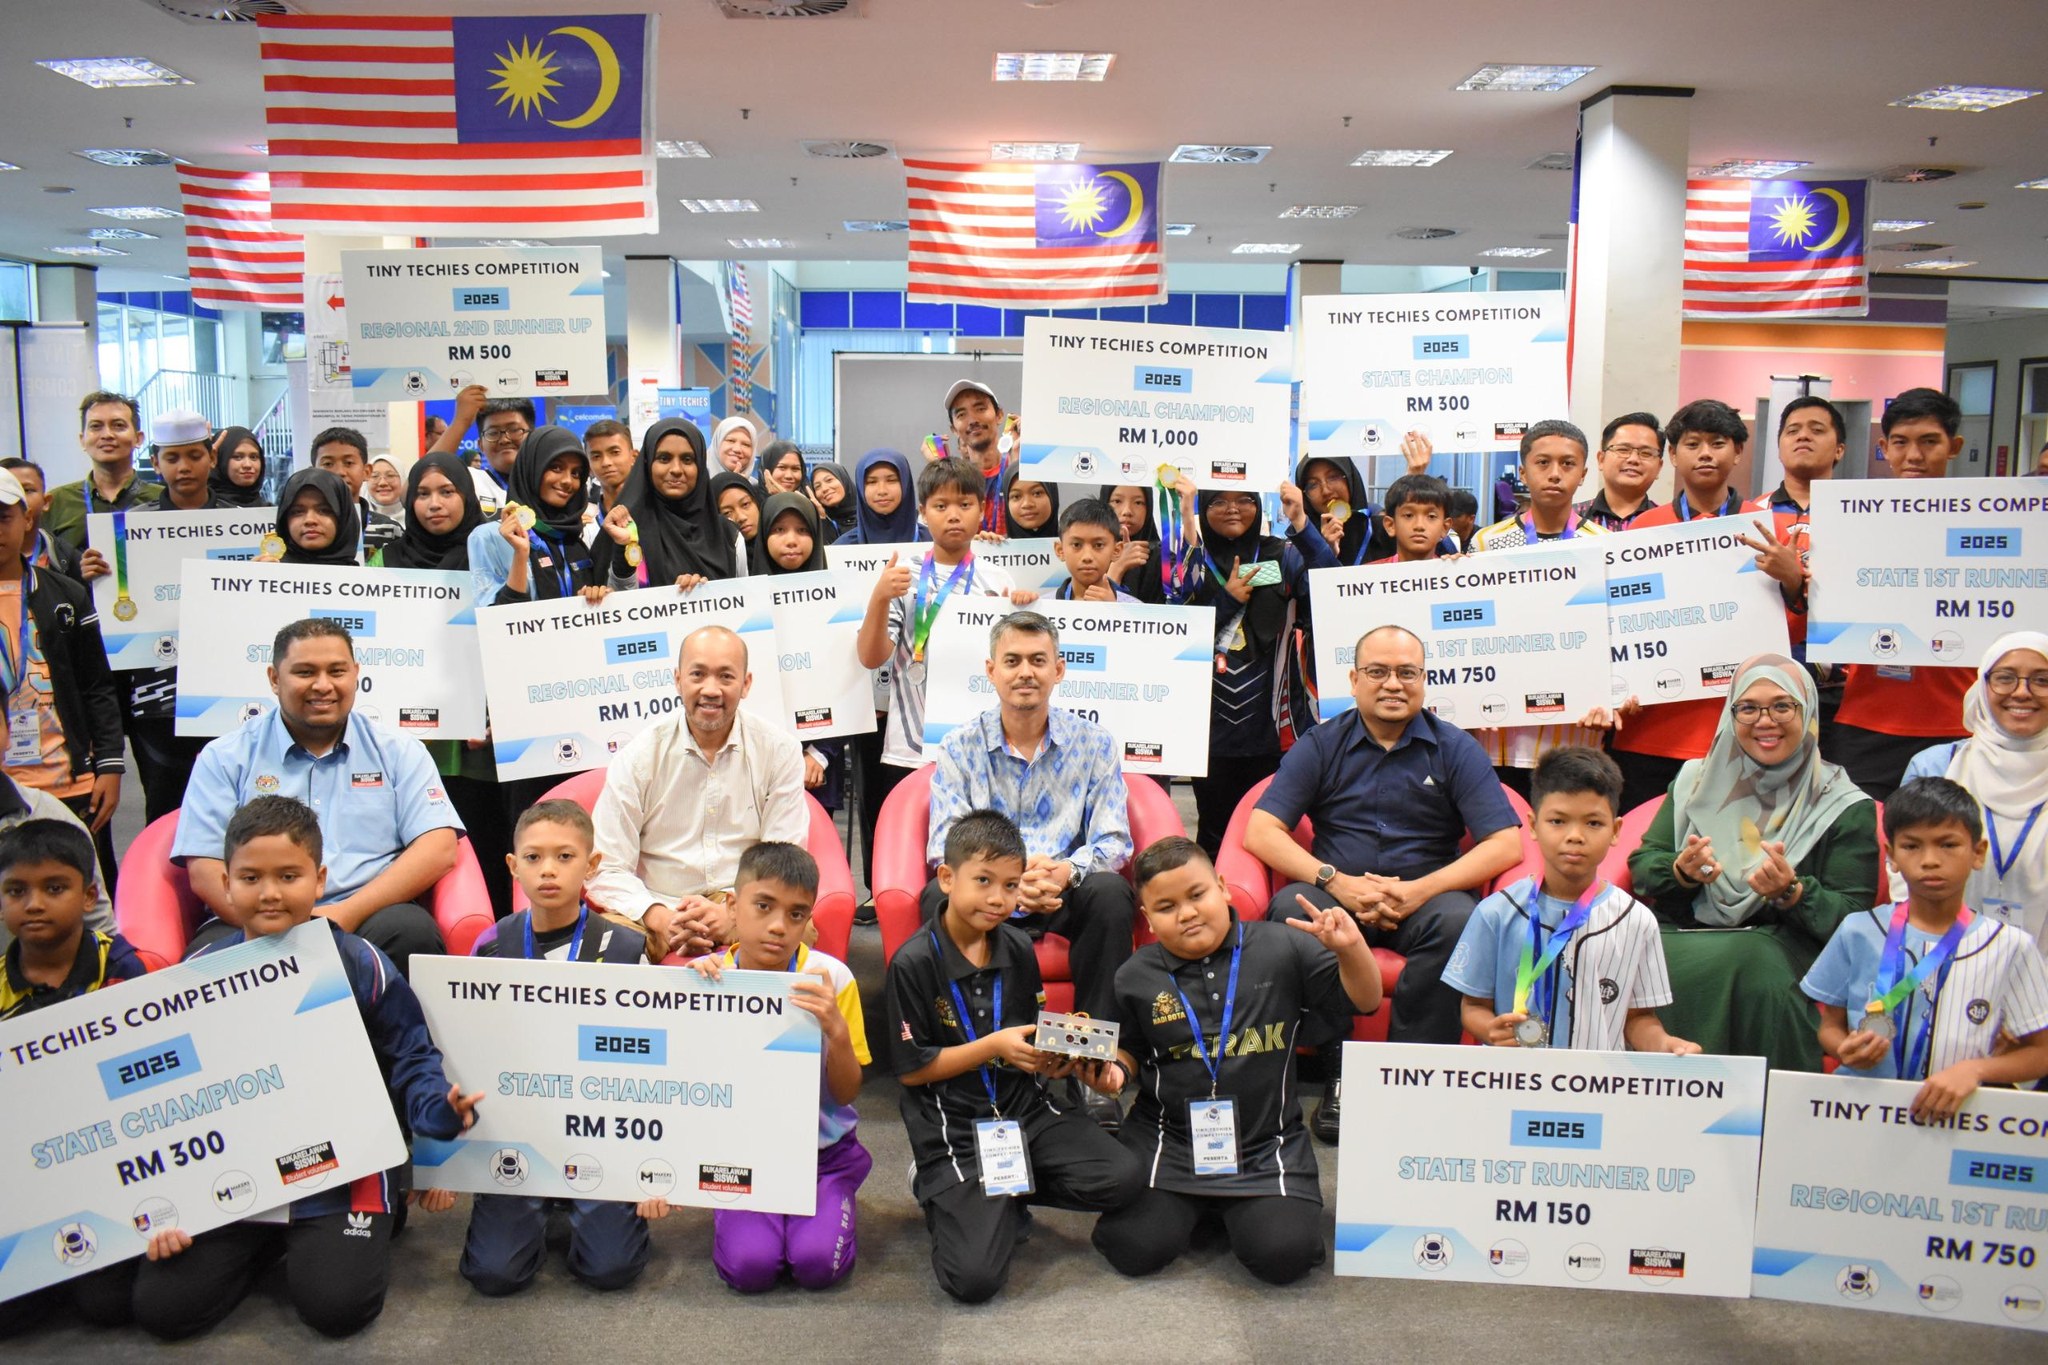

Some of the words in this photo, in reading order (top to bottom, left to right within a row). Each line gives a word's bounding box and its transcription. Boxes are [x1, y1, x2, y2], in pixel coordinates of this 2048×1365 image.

[367, 263, 402, 277] TINY
[407, 263, 470, 276] TECHIES
[475, 262, 580, 275] COMPETITION
[464, 294, 499, 305] 2025
[1328, 311, 1362, 325] TINY
[1367, 310, 1430, 323] TECHIES
[1435, 307, 1541, 322] COMPETITION
[360, 321, 451, 339] REGIONAL
[454, 320, 489, 336] 2ND
[493, 318, 565, 335] RUNNER
[569, 318, 592, 333] UP
[448, 346, 474, 360] RM
[480, 345, 511, 359] 500
[1049, 335, 1085, 349] TINY
[1091, 337, 1155, 353] TECHIES
[1160, 341, 1268, 359] COMPETITION
[1423, 341, 1459, 353] 2025
[1145, 373, 1181, 386] 2025
[1362, 370, 1411, 387] STATE
[1415, 368, 1513, 387] CHAMPION
[660, 397, 676, 407] TINY
[679, 397, 708, 407] TECHIES
[1058, 396, 1150, 418] REGIONAL
[1154, 401, 1254, 423] CHAMPION
[1407, 396, 1433, 412] RM
[1438, 395, 1470, 411] 300
[1119, 427, 1146, 444] RM
[1151, 429, 1198, 448] 1,000
[1840, 499, 1884, 513] TINY
[1891, 498, 1971, 512] TECHIES
[125, 528, 151, 541] INY
[158, 524, 224, 539] TECHIES
[1961, 536, 2008, 549] 2025
[1621, 533, 1746, 563] COMPETITION
[983, 554, 1050, 566] PETITION
[1336, 582, 1375, 597] TINY
[1380, 576, 1450, 594] TECHIES
[1455, 566, 1577, 588] COMPETITION
[1856, 567, 1919, 588] STATE
[1924, 568, 1960, 588] 1ST
[211, 577, 253, 592] TINY
[259, 580, 333, 595] TECHIES
[338, 583, 461, 599] COMPETITION
[773, 587, 836, 605] ETITION
[1610, 582, 1652, 599] 2025
[506, 618, 545, 636] TINY
[551, 610, 622, 630] TECHIES
[628, 595, 745, 621] COMPETITION
[1443, 608, 1483, 622] 2025
[1619, 606, 1706, 634] RUNNER
[1710, 602, 1739, 621] UP
[1936, 600, 1970, 618] RM
[1978, 600, 2015, 618] 150
[323, 617, 364, 630] 025
[957, 612, 994, 625] TINY
[1072, 618, 1188, 636] COMPETITION
[617, 640, 657, 656] 2025
[1437, 639, 1467, 657] 1ST
[1471, 633, 1556, 655] RUNNER
[1560, 630, 1587, 650] UP
[1611, 646, 1629, 663] M
[1634, 640, 1668, 660] 150
[355, 648, 424, 667] MPION
[1059, 651, 1095, 663] 2025
[1427, 668, 1456, 685] RM
[1462, 665, 1496, 684] 750
[527, 677, 629, 703] REGIONAL
[1059, 679, 1138, 701] RUNNER
[1143, 684, 1169, 702] UP
[599, 703, 629, 722] RM
[448, 981, 503, 1001] TINY
[509, 984, 607, 1006] TECHIES
[616, 989, 783, 1015] COMPETITION
[10, 1016, 118, 1066] TECHIES
[124, 955, 301, 1028] COMPETITION
[595, 1035, 650, 1055] 2025
[118, 1050, 182, 1085] 2025
[498, 1071, 573, 1099] STATE
[580, 1075, 733, 1108] CHAMPION
[1380, 1068, 1434, 1088] TINY
[1443, 1070, 1542, 1091] TECHIES
[1551, 1074, 1724, 1099] COMPETITION
[31, 1120, 118, 1170] STATE
[120, 1064, 285, 1139] CHAMPION
[1810, 1099, 1870, 1121] TINY
[565, 1114, 606, 1139] RM
[615, 1117, 664, 1142] 300
[1527, 1121, 1585, 1139] 2025
[116, 1150, 166, 1186] RM
[170, 1130, 226, 1167] 300
[293, 1153, 323, 1170] SISWA
[702, 1165, 749, 1177] SUKARELAWAN
[713, 1173, 739, 1184] SISWA
[1398, 1156, 1476, 1183] STATE
[1482, 1160, 1526, 1185] 1ST
[1531, 1162, 1649, 1192] RUNNER
[1656, 1167, 1695, 1193] UP
[1969, 1161, 2034, 1183] 2025
[1496, 1200, 1537, 1223] RM
[1546, 1202, 1591, 1226] 150
[1790, 1184, 1944, 1222] REGIONAL
[1952, 1199, 2000, 1227] 1ST
[343, 1228, 371, 1238] adidas
[1633, 1250, 1682, 1260] SUKARELAWAN
[1926, 1235, 1973, 1262] RM
[1982, 1241, 2036, 1268] 750
[1644, 1257, 1672, 1268] SISWA
